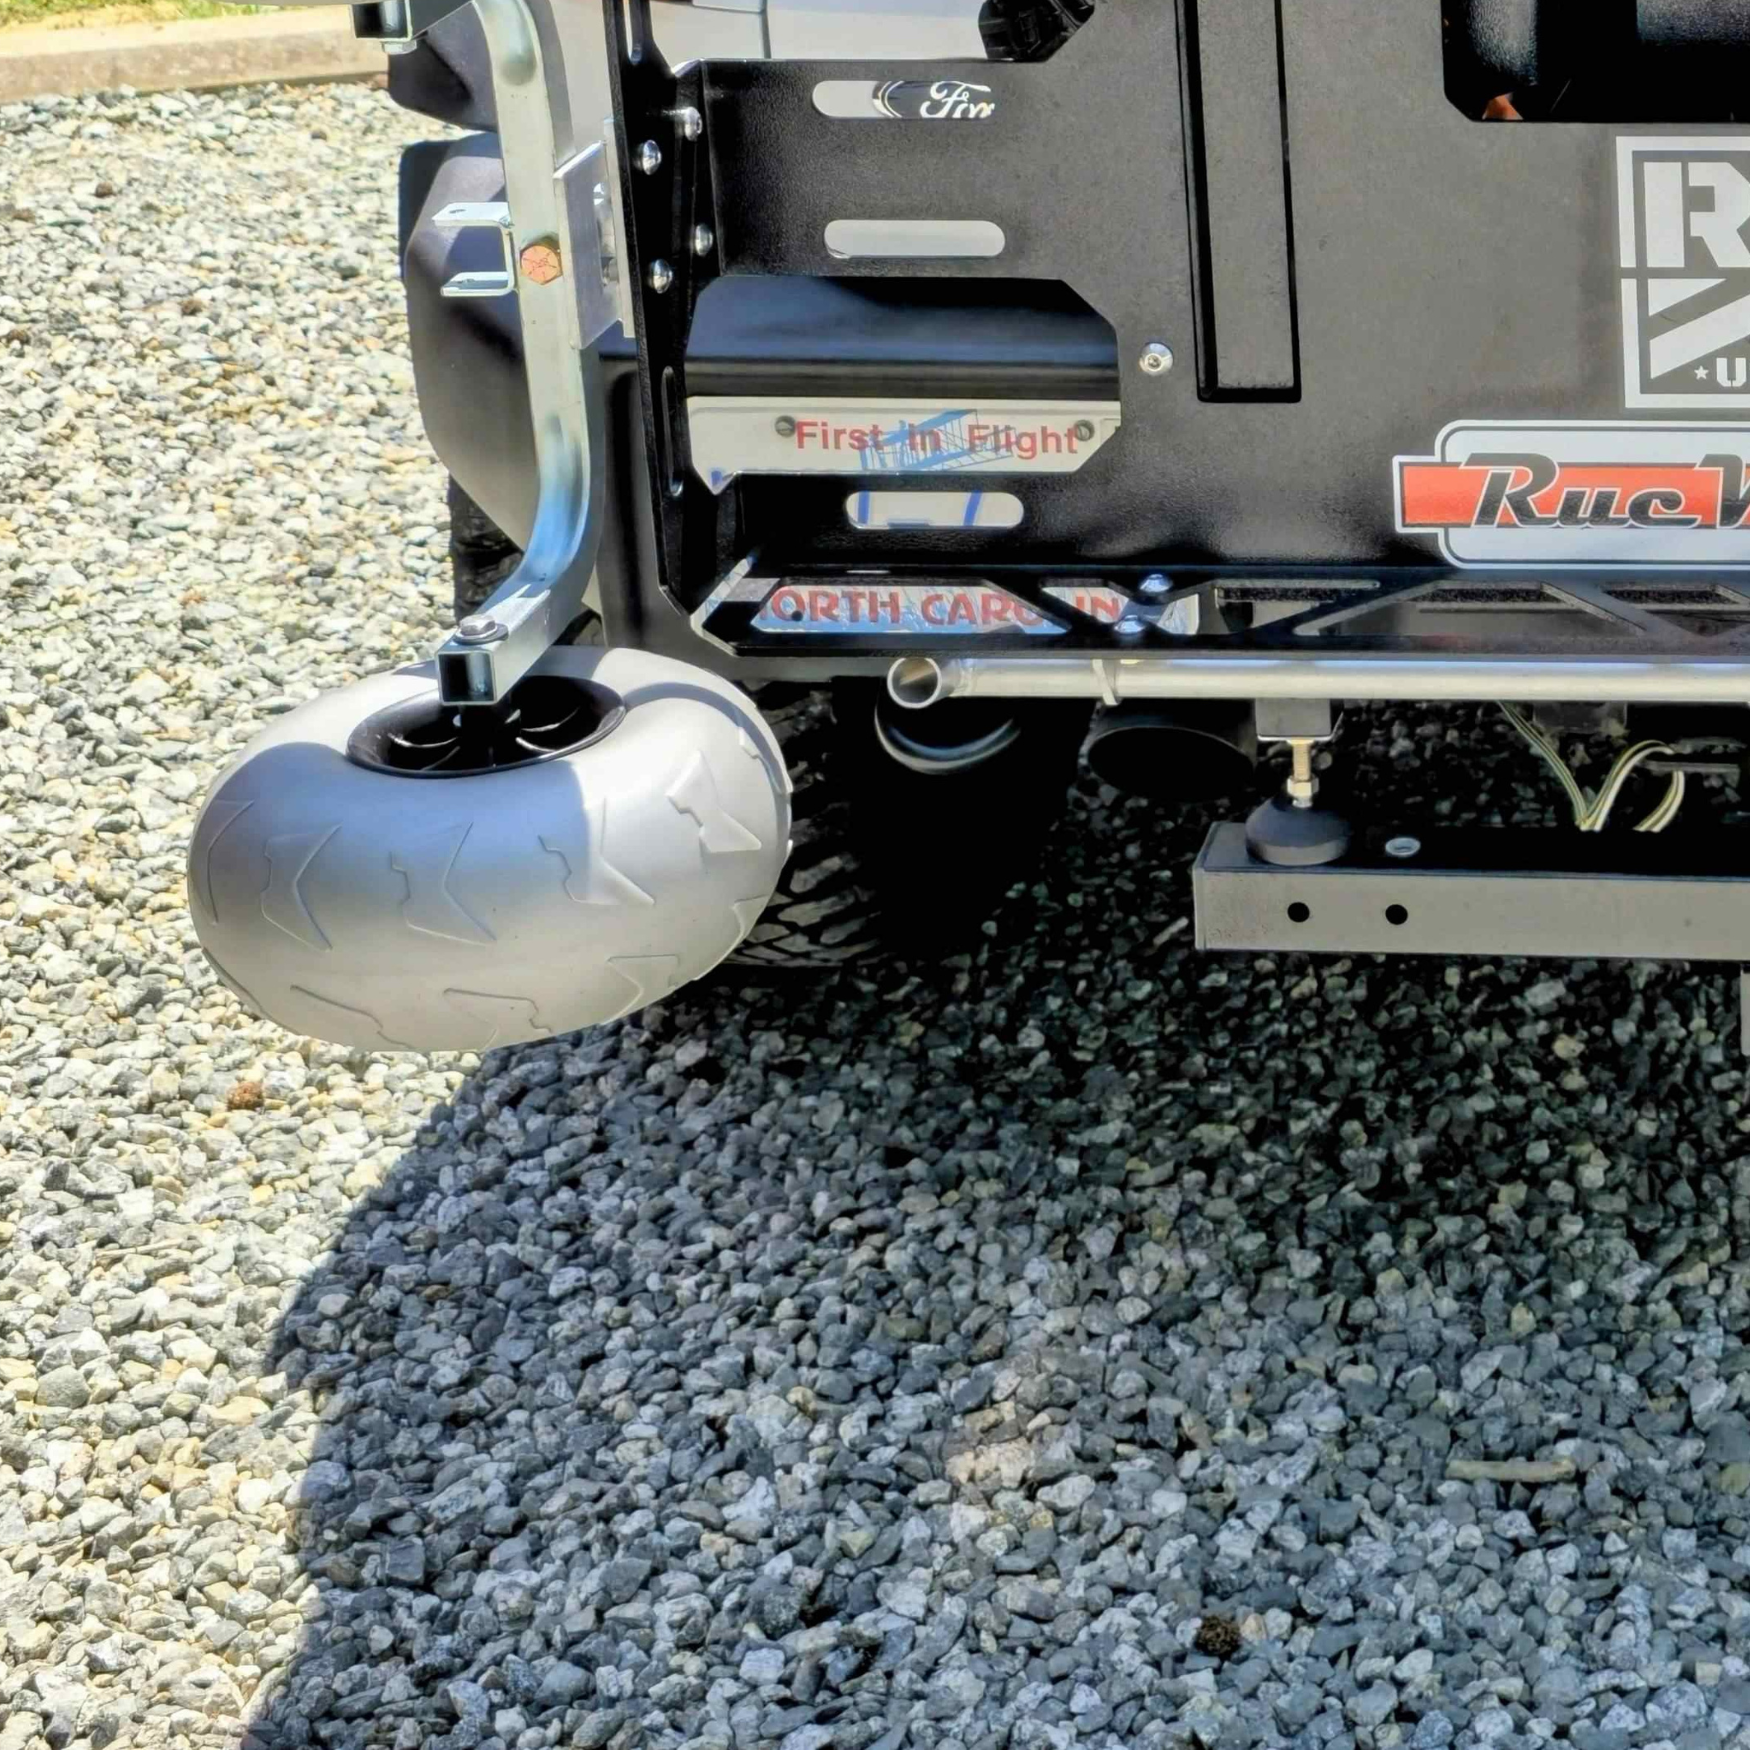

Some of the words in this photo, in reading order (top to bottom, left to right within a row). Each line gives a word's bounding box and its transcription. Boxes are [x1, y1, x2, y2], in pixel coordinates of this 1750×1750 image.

[794, 420, 884, 451] First
[967, 424, 1080, 460] Flight
[758, 588, 901, 624] ORTH
